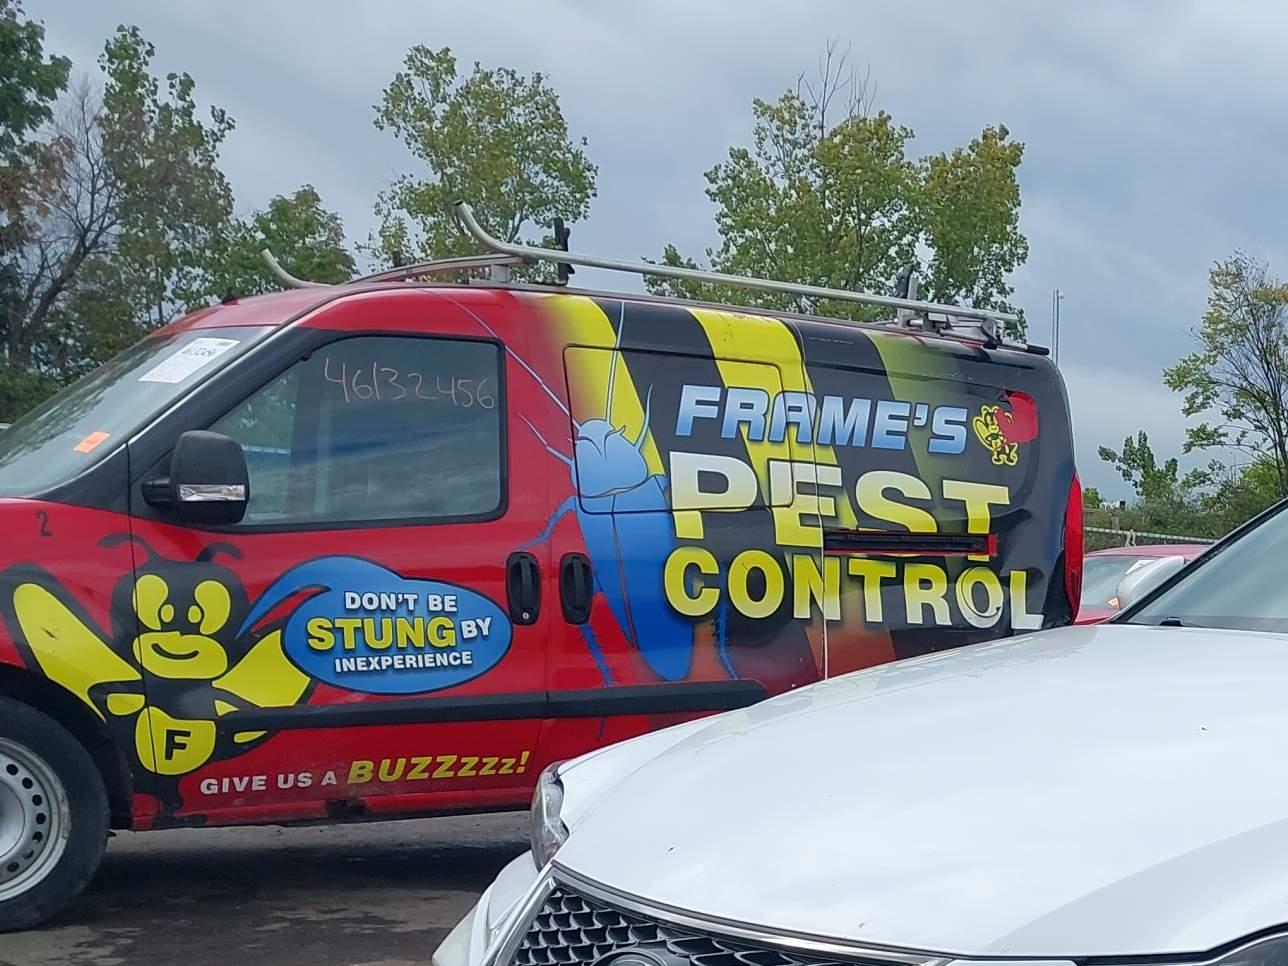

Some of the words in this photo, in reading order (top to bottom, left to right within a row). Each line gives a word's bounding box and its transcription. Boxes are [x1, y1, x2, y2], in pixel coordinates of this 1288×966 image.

[324, 357, 496, 409] 46132456
[675, 384, 969, 455] FRAME'S
[669, 450, 1011, 563] PEST
[36, 511, 53, 537] 2
[344, 591, 418, 612] DON'T
[428, 594, 458, 612] BE
[664, 546, 1044, 630] CONTROL
[306, 616, 457, 650] STUNG
[461, 616, 492, 639] BY
[334, 651, 473, 673] INEXPERIENCE
[165, 729, 191, 760] F
[200, 775, 267, 795] GIVE
[277, 772, 313, 789] US
[320, 770, 338, 786] A
